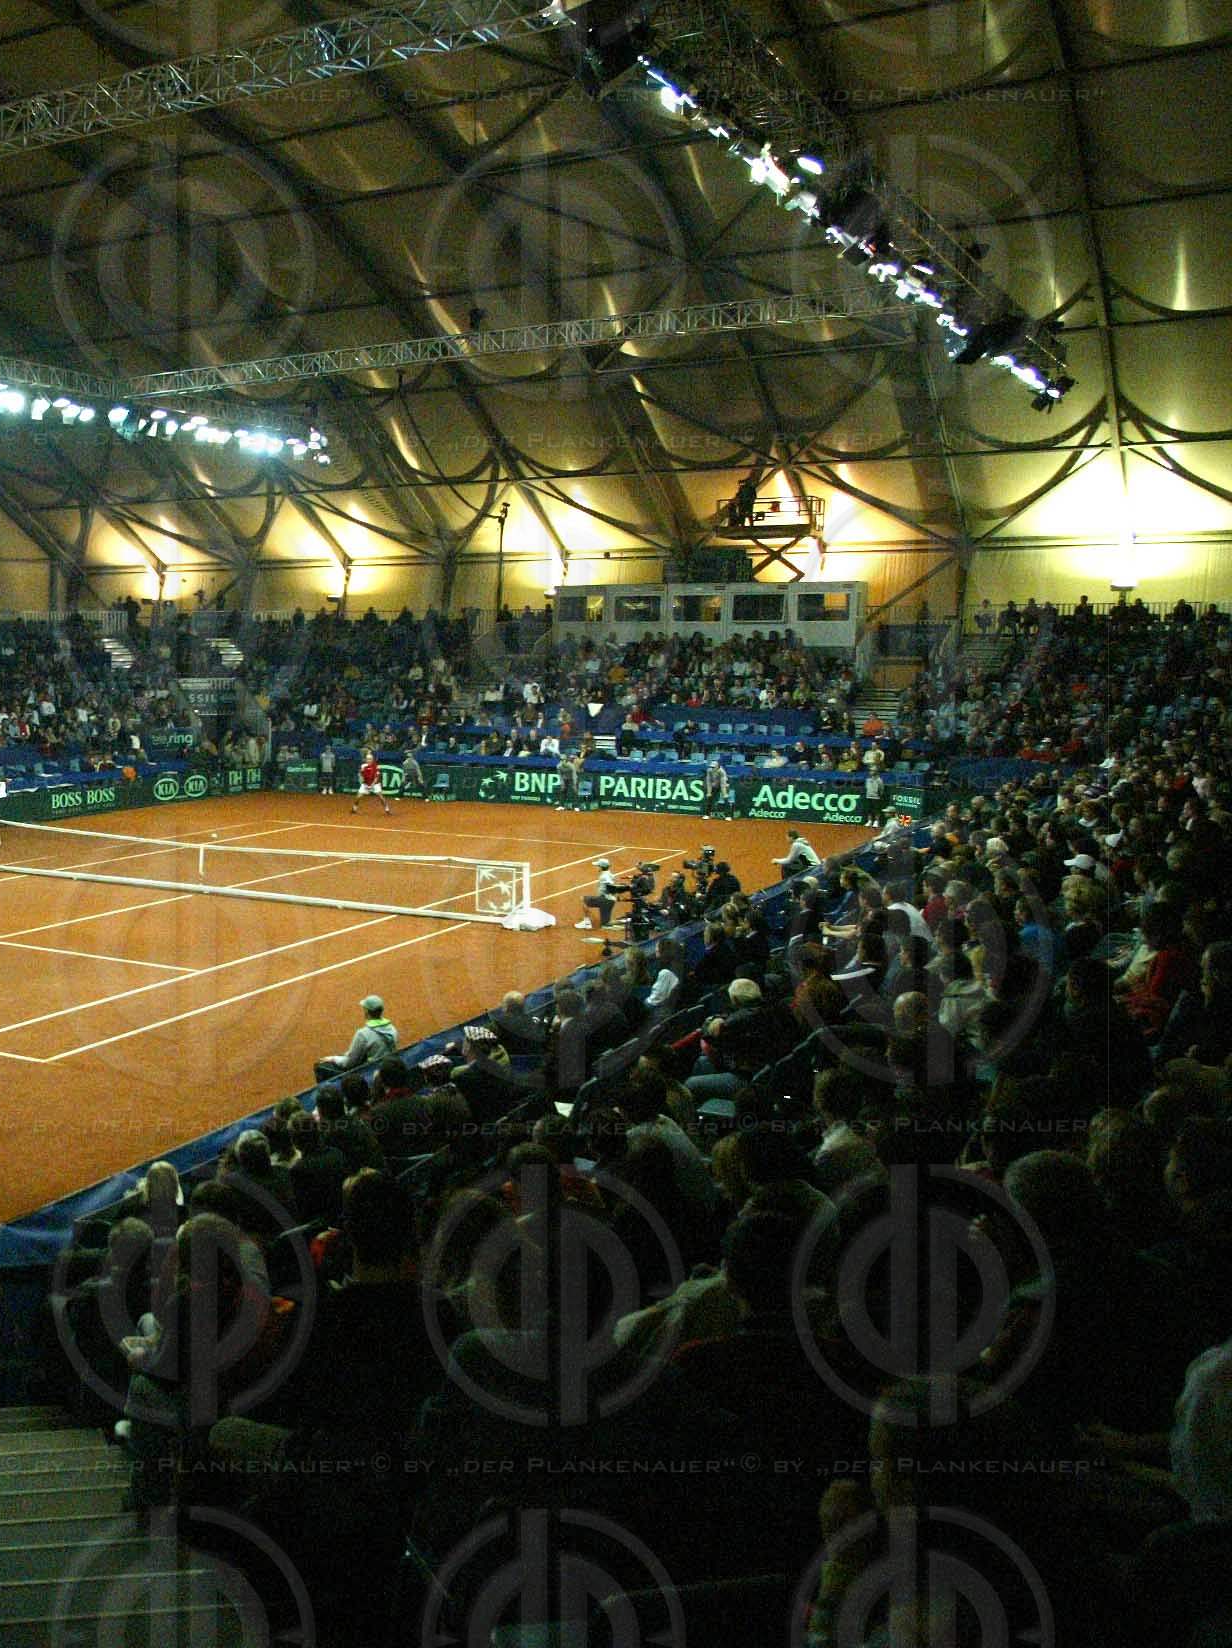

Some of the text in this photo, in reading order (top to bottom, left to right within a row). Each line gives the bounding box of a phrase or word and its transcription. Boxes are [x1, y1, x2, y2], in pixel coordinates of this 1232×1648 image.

[51, 791, 82, 809] BOSS
[87, 787, 116, 804] BOSS
[514, 771, 705, 802] BNP PARIBAS
[752, 784, 861, 812] Adecco
[823, 813, 865, 823] Adecco
